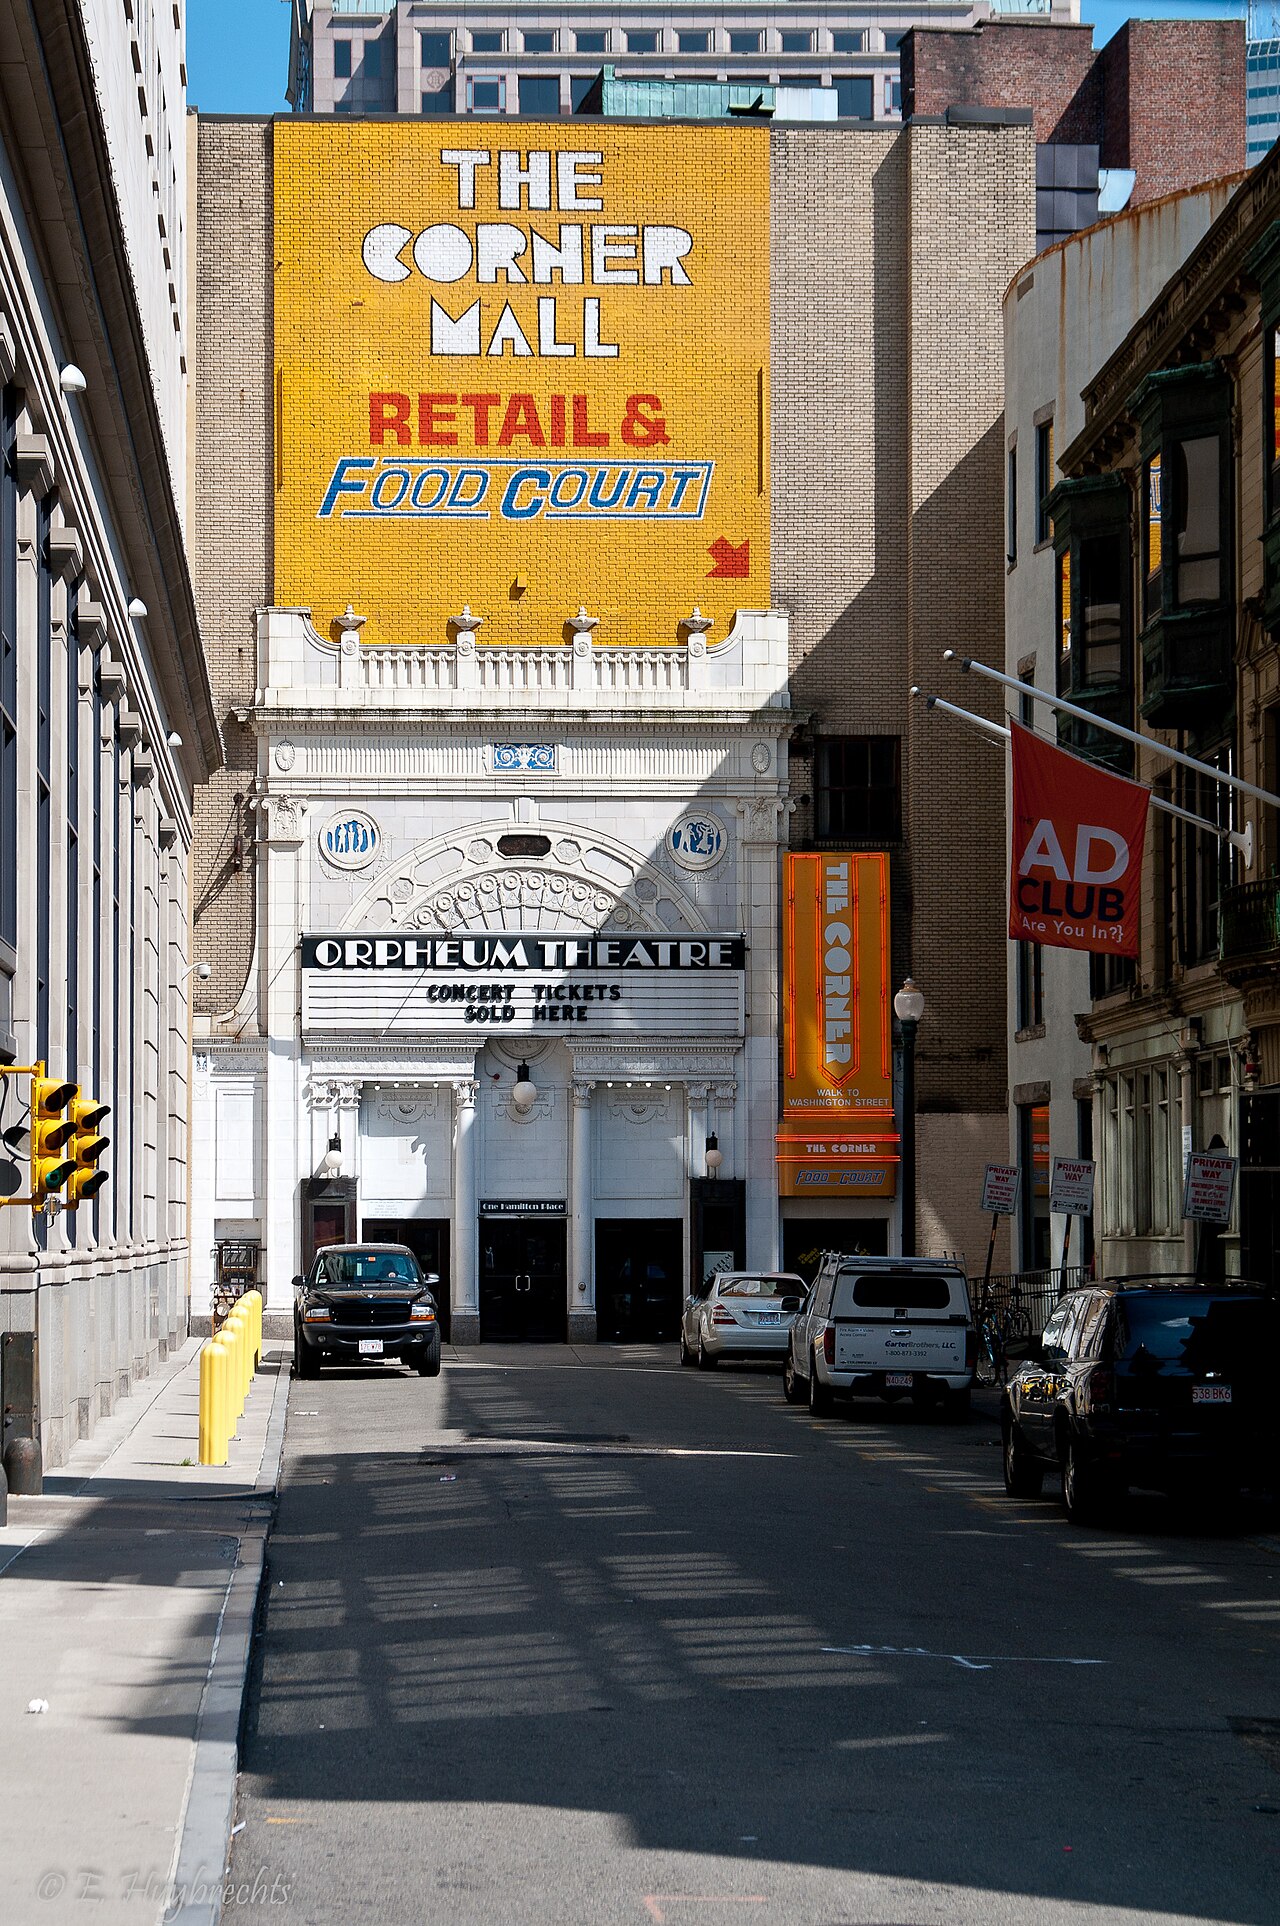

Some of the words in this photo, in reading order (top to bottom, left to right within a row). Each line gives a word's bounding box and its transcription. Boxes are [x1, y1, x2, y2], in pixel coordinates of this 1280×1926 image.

[440, 148, 604, 212] THE
[361, 222, 694, 286] CORNER
[430, 296, 620, 358] MALL
[369, 393, 610, 447] RETAIL
[620, 393, 671, 448] &
[316, 457, 490, 519] FOOD
[500, 463, 705, 520] COURT
[1018, 819, 1130, 885] AD
[826, 863, 848, 914] THE
[1017, 877, 1126, 923] CLUB
[1020, 913, 1046, 931] Are
[1053, 920, 1084, 937] You
[315, 939, 529, 967] ORPHEUM
[542, 941, 733, 967] THEATRE
[428, 985, 515, 1001] CONCERT
[534, 985, 622, 1001] TICKETS
[825, 922, 851, 1065] CORNER
[466, 1005, 515, 1021] SOLD
[534, 1006, 588, 1021] HERE
[789, 1098, 851, 1107] WASHINGTON
[854, 1098, 889, 1107] STREET
[817, 1088, 845, 1097] WALK
[847, 1088, 860, 1097] TO
[806, 1144, 826, 1153] THE
[831, 1144, 876, 1153] CORNER
[988, 1166, 1018, 1176] PRIVATE
[1057, 1162, 1093, 1174] PRIVATE
[1193, 1158, 1233, 1169] PRIVATE
[795, 1170, 829, 1185] FOOD
[840, 1171, 884, 1185] COURT
[1064, 1172, 1083, 1181] WAY
[1202, 1170, 1221, 1179] WAY
